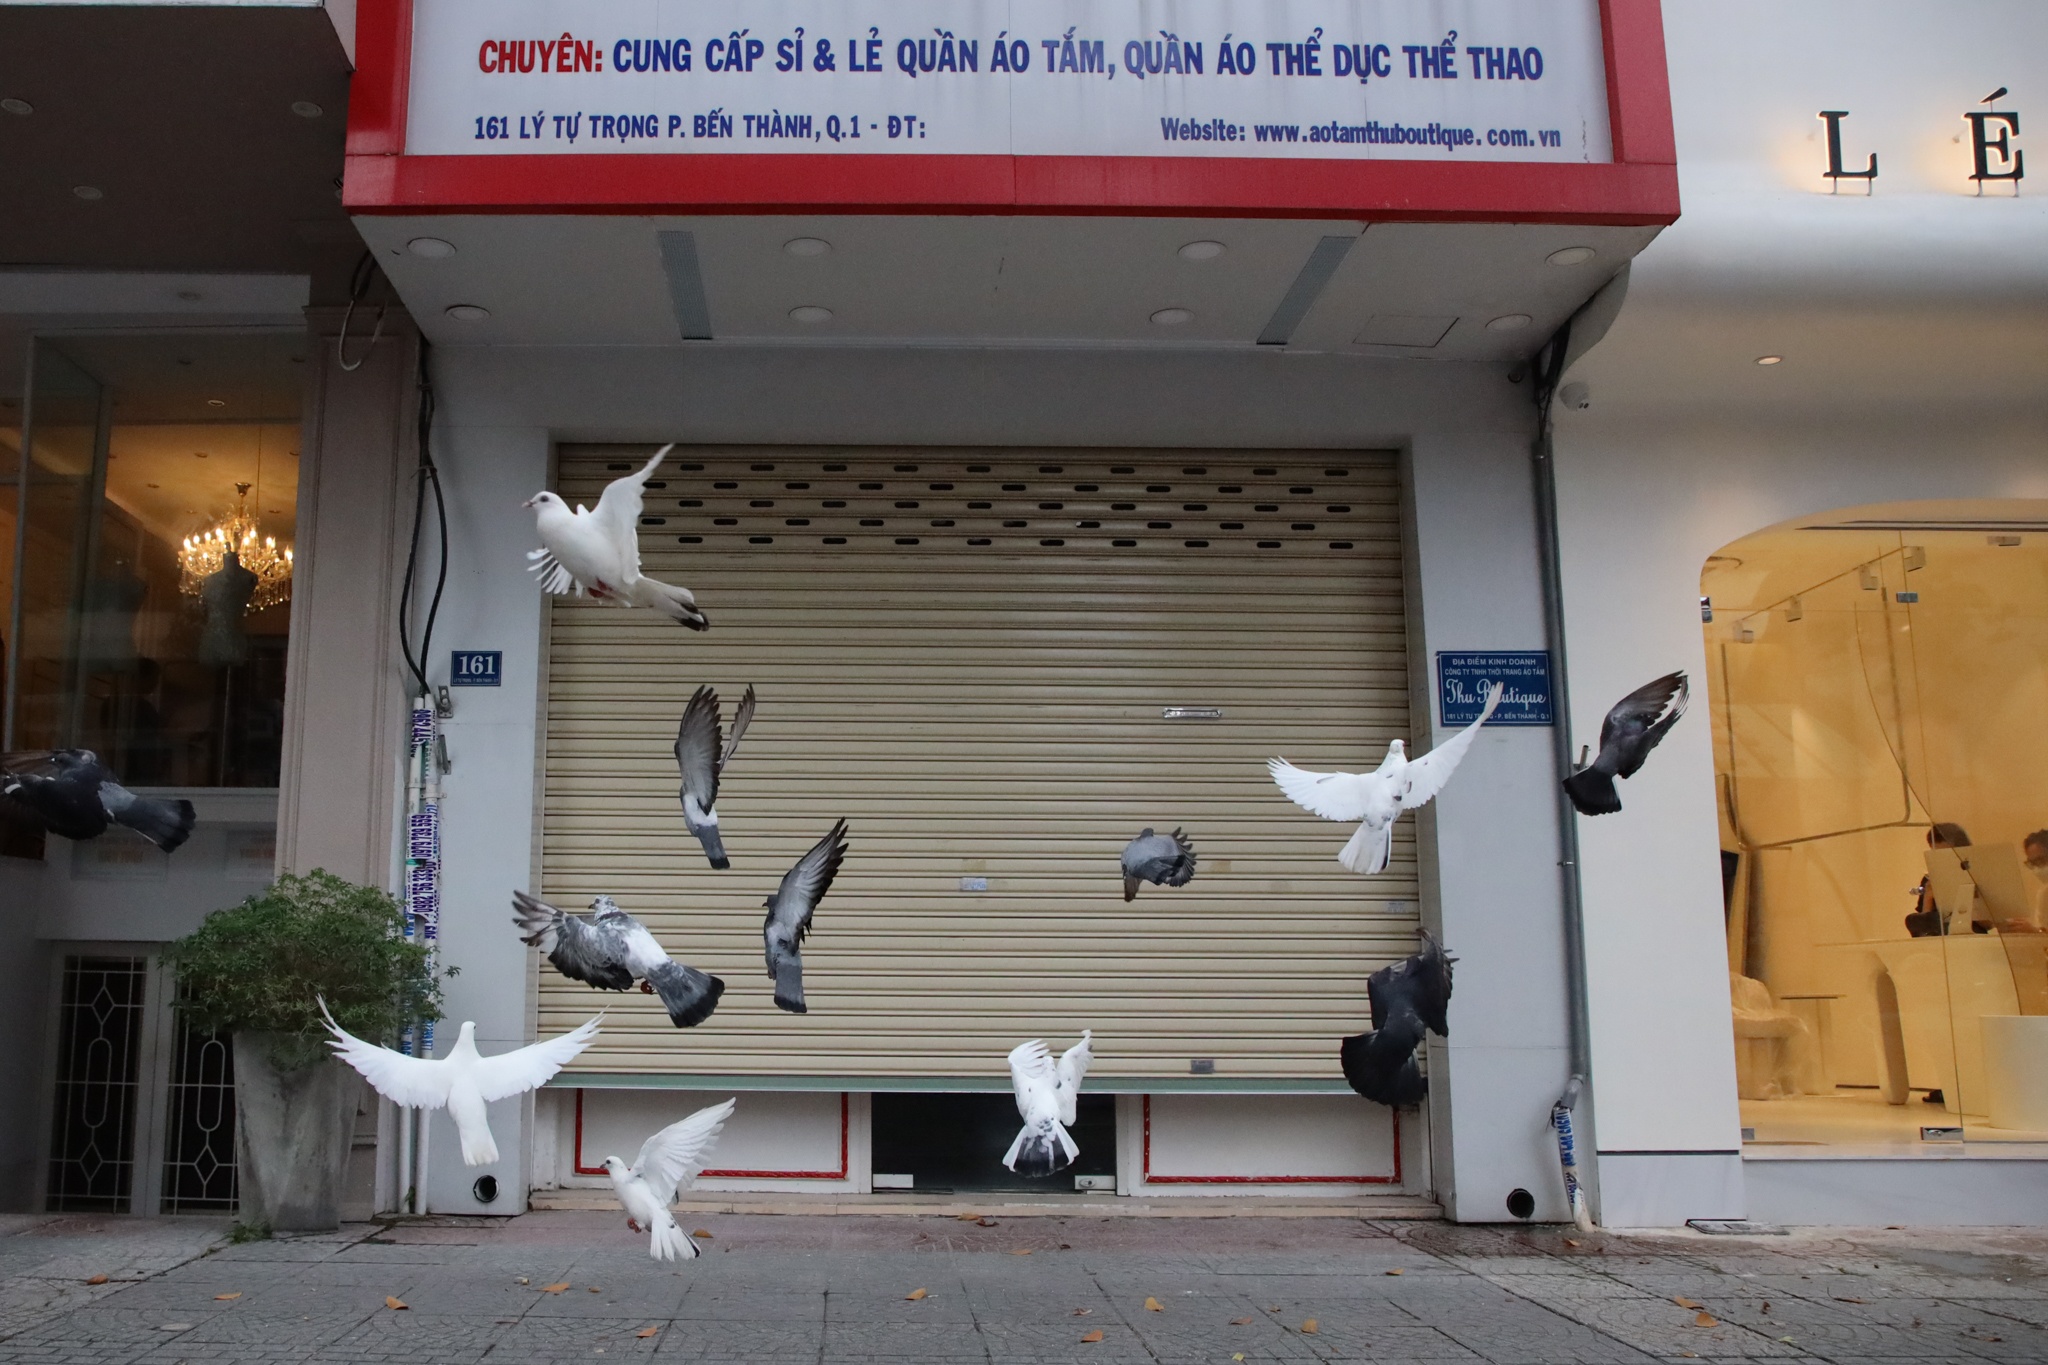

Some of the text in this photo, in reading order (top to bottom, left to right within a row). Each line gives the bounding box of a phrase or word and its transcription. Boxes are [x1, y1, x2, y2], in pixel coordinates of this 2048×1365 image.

[480, 26, 1546, 86] CHUYÊN: CUNG CẤP SỈ & LẺ QUẦN ÁO TẮM, QUẦN ÁO THỂ DỤC THỂ THAO
[475, 116, 510, 140] 161
[520, 111, 546, 140] LÝ
[553, 112, 584, 143] TỰ
[589, 115, 660, 143] TRỌNG
[669, 114, 688, 139] P.
[694, 107, 735, 139] BẾN
[888, 115, 928, 139] ĐT:
[1160, 116, 1247, 142] Website:
[459, 655, 496, 675] 161
[1444, 667, 1462, 676] CÔNG
[1502, 668, 1522, 676] TRANG
[1523, 666, 1532, 676] ÁO
[1452, 656, 1536, 666] ĐỊA ĐIỂM KINH DOANH
[1445, 678, 1547, 711] Thu Butique
